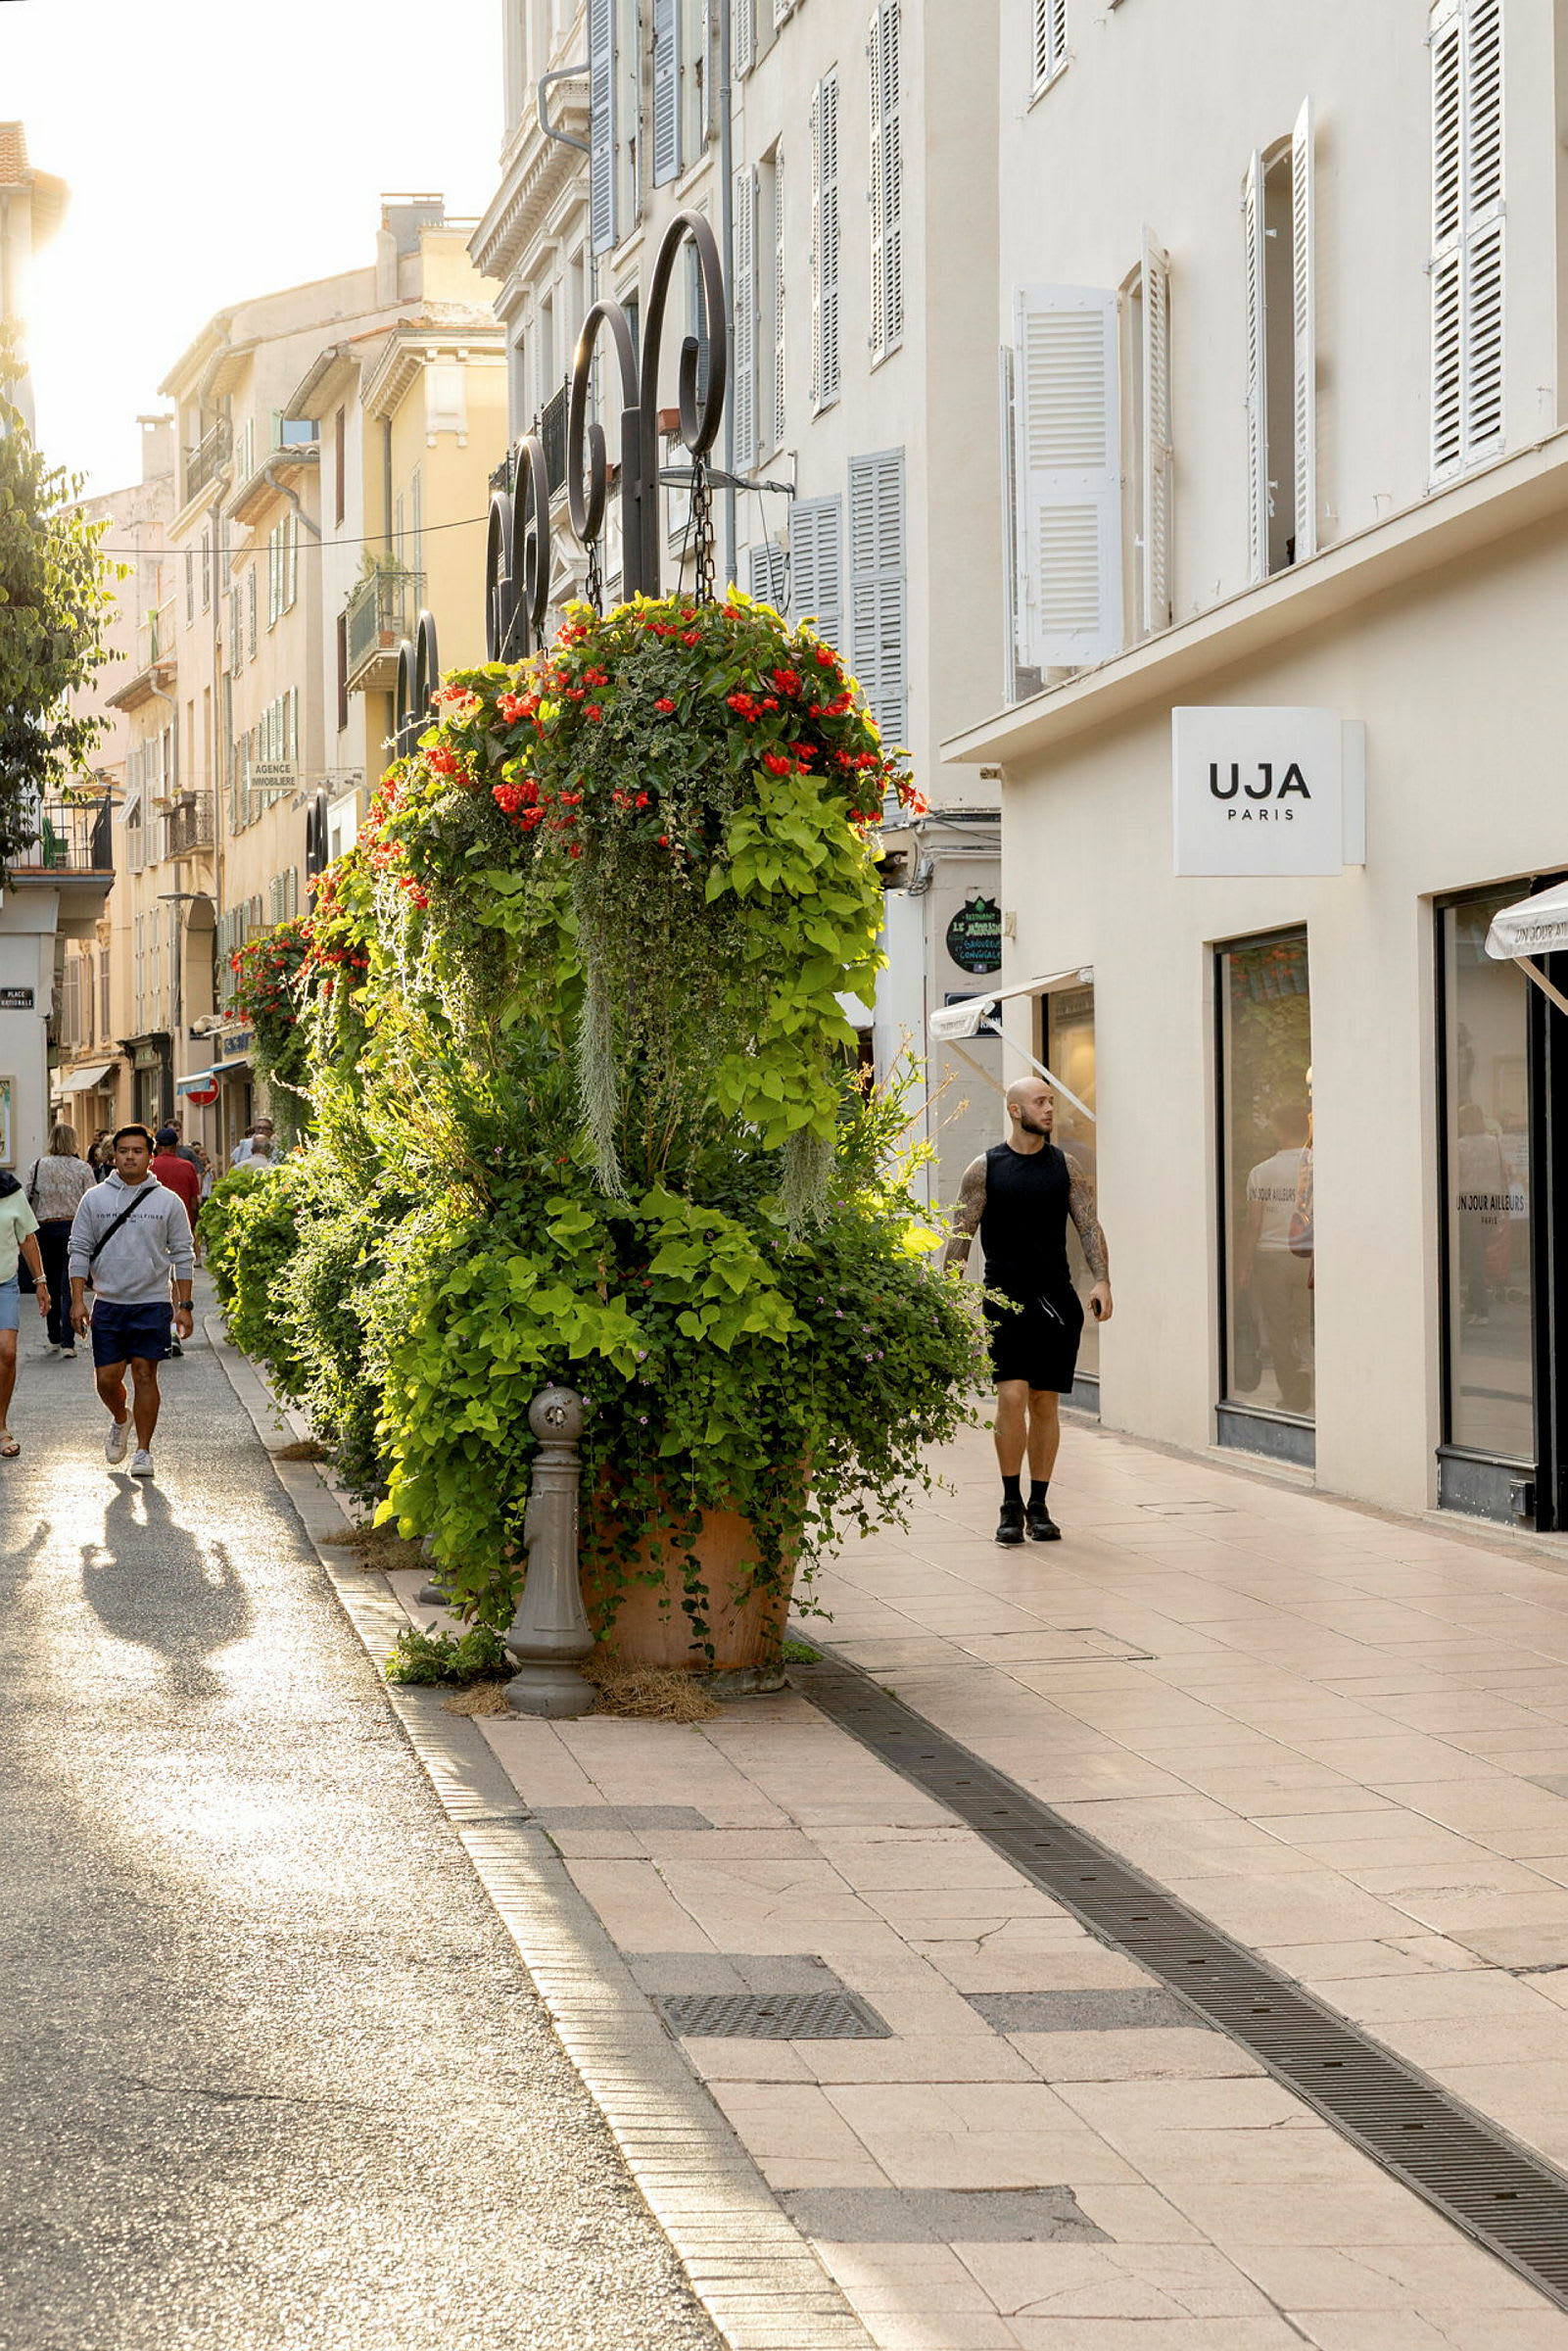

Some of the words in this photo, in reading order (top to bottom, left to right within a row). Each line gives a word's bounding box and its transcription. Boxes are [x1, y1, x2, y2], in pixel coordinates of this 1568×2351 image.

[256, 764, 291, 774] AGENCE
[1210, 763, 1311, 799] UJA
[1228, 809, 1294, 820] PARIS
[1456, 1195, 1466, 1210] UN
[1468, 1195, 1489, 1210] JOUR
[1490, 1195, 1524, 1211] AILLEURS
